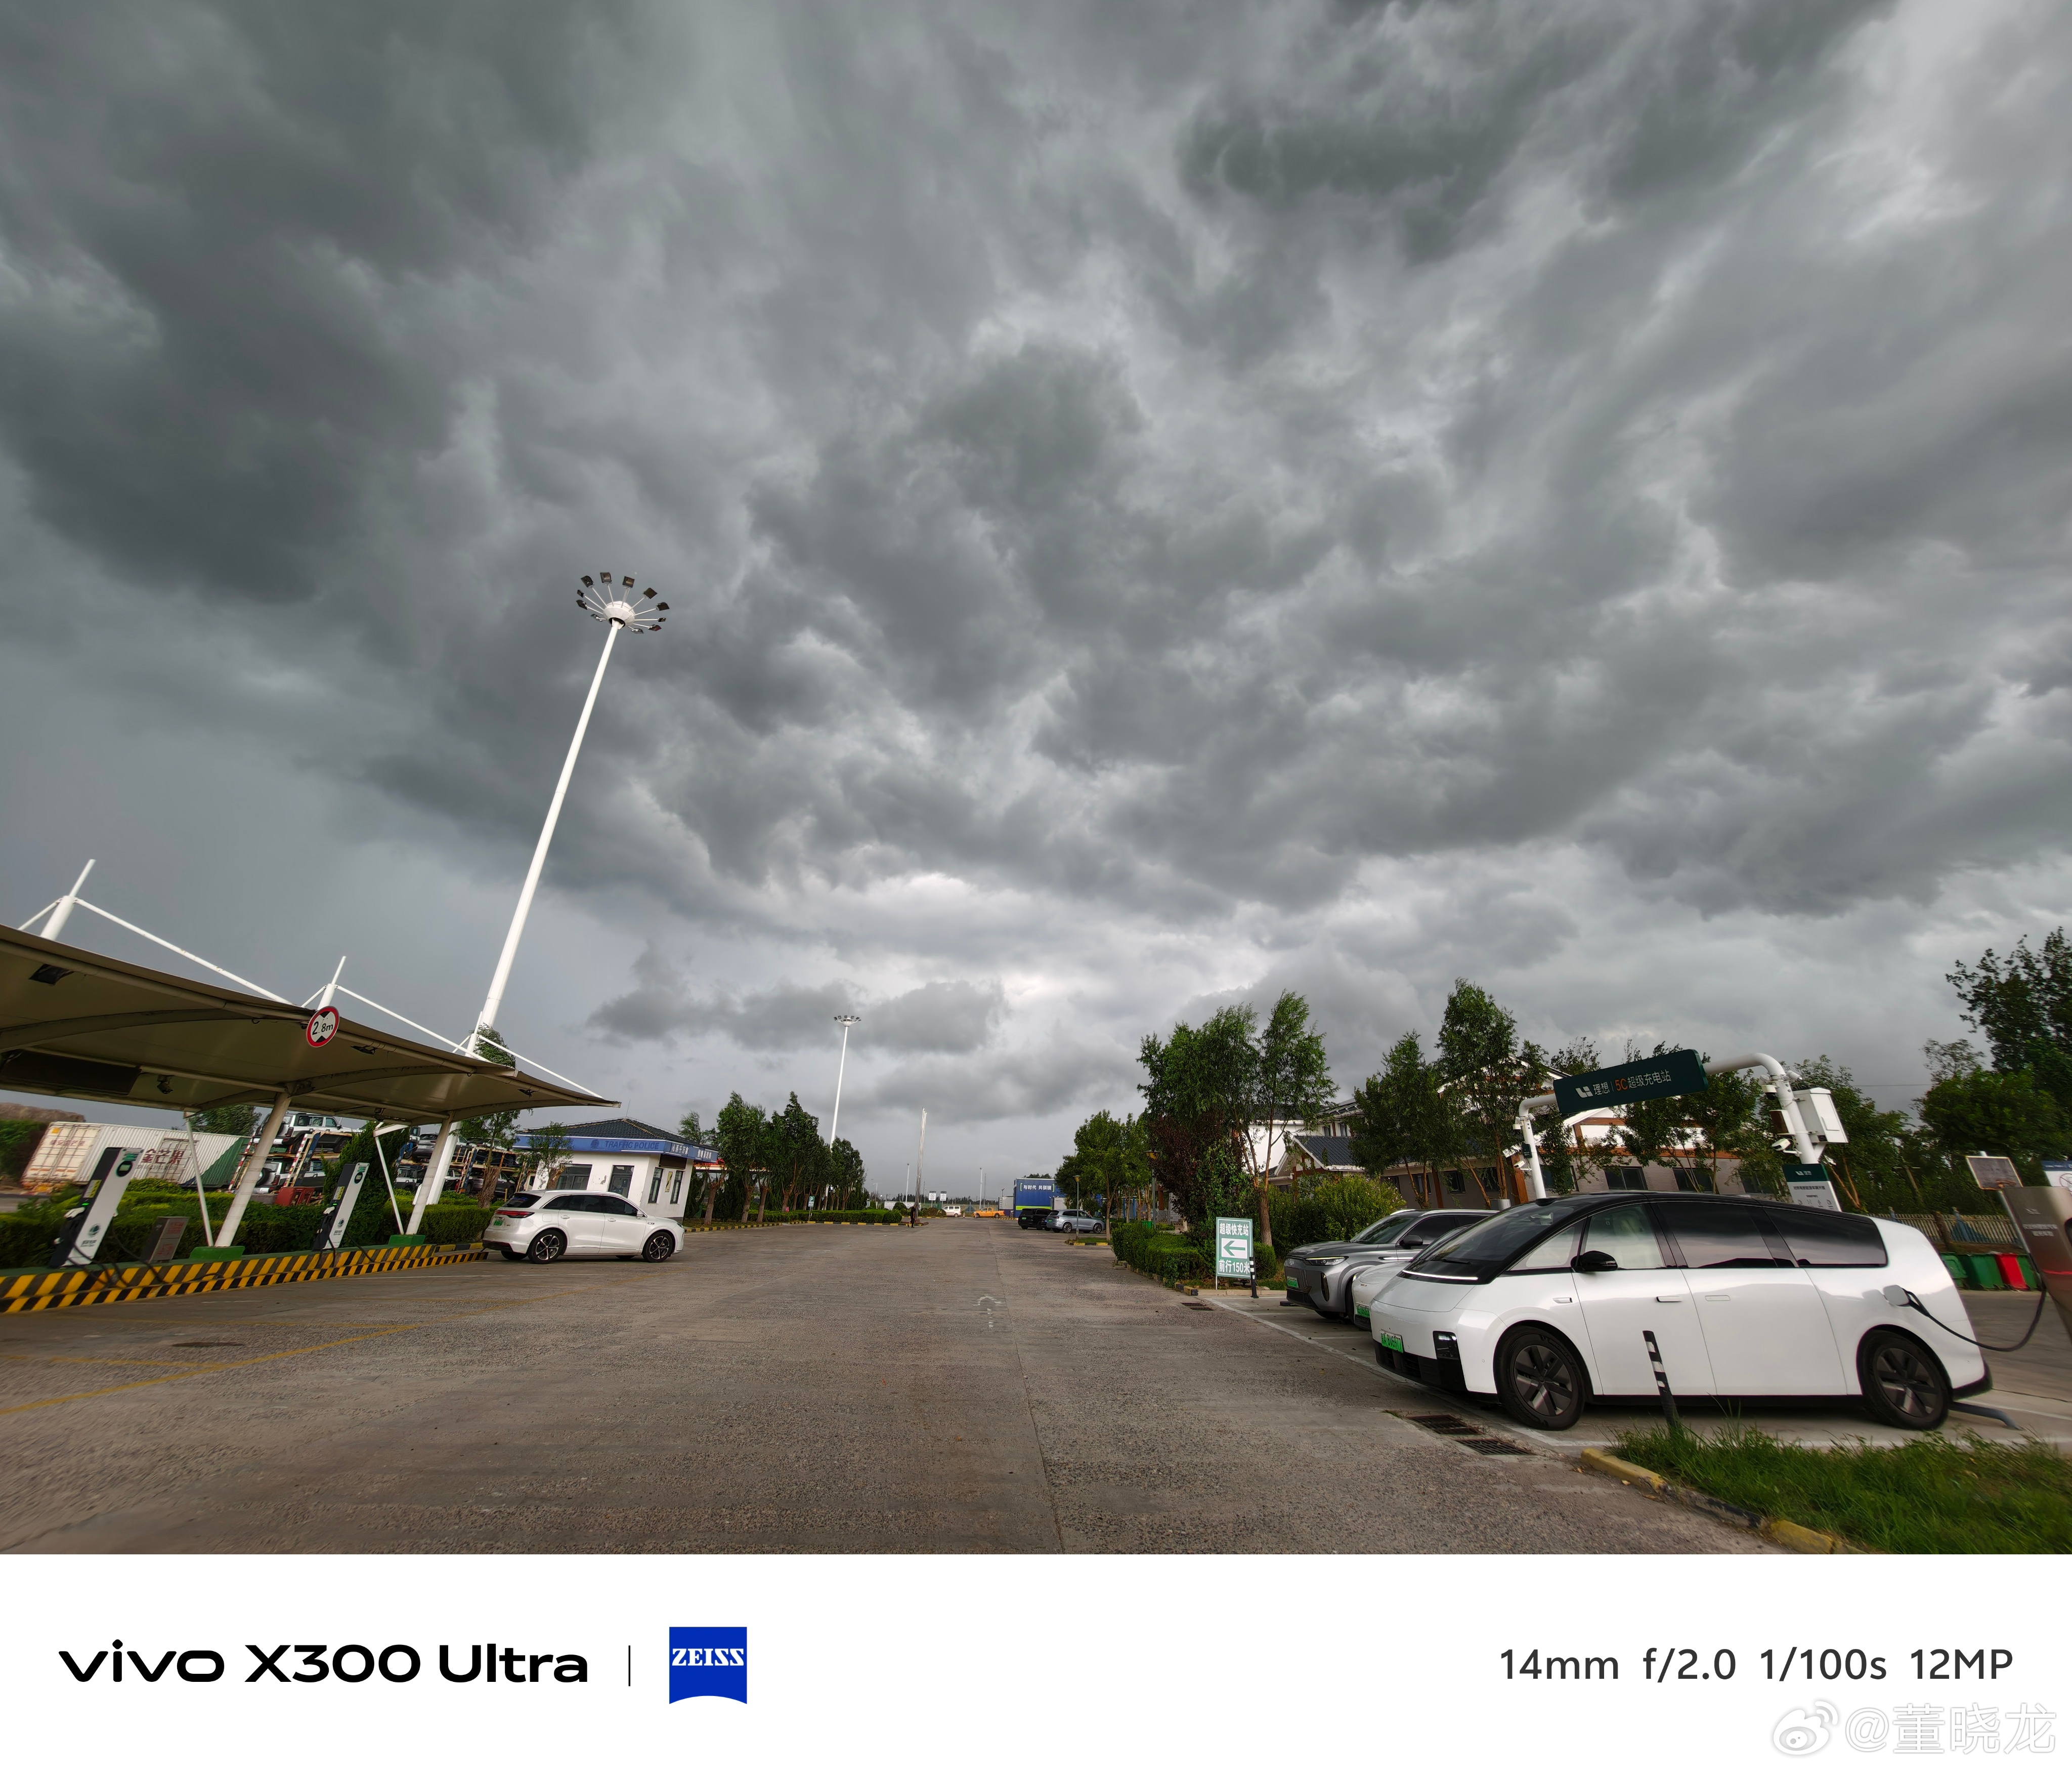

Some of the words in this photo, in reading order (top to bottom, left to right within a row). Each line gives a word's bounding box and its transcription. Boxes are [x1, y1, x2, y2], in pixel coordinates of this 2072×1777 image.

[312, 1021, 333, 1035] 2.8m
[1593, 1082, 1610, 1096] 理想
[1615, 1069, 1671, 1091] 5C超级充电站
[605, 1140, 633, 1149] TRAFFIC
[634, 1142, 660, 1150] POLICE
[141, 1148, 184, 1164] 金芒果
[1220, 1222, 1249, 1236] 超级快充站
[1219, 1259, 1250, 1275] 前行150米
